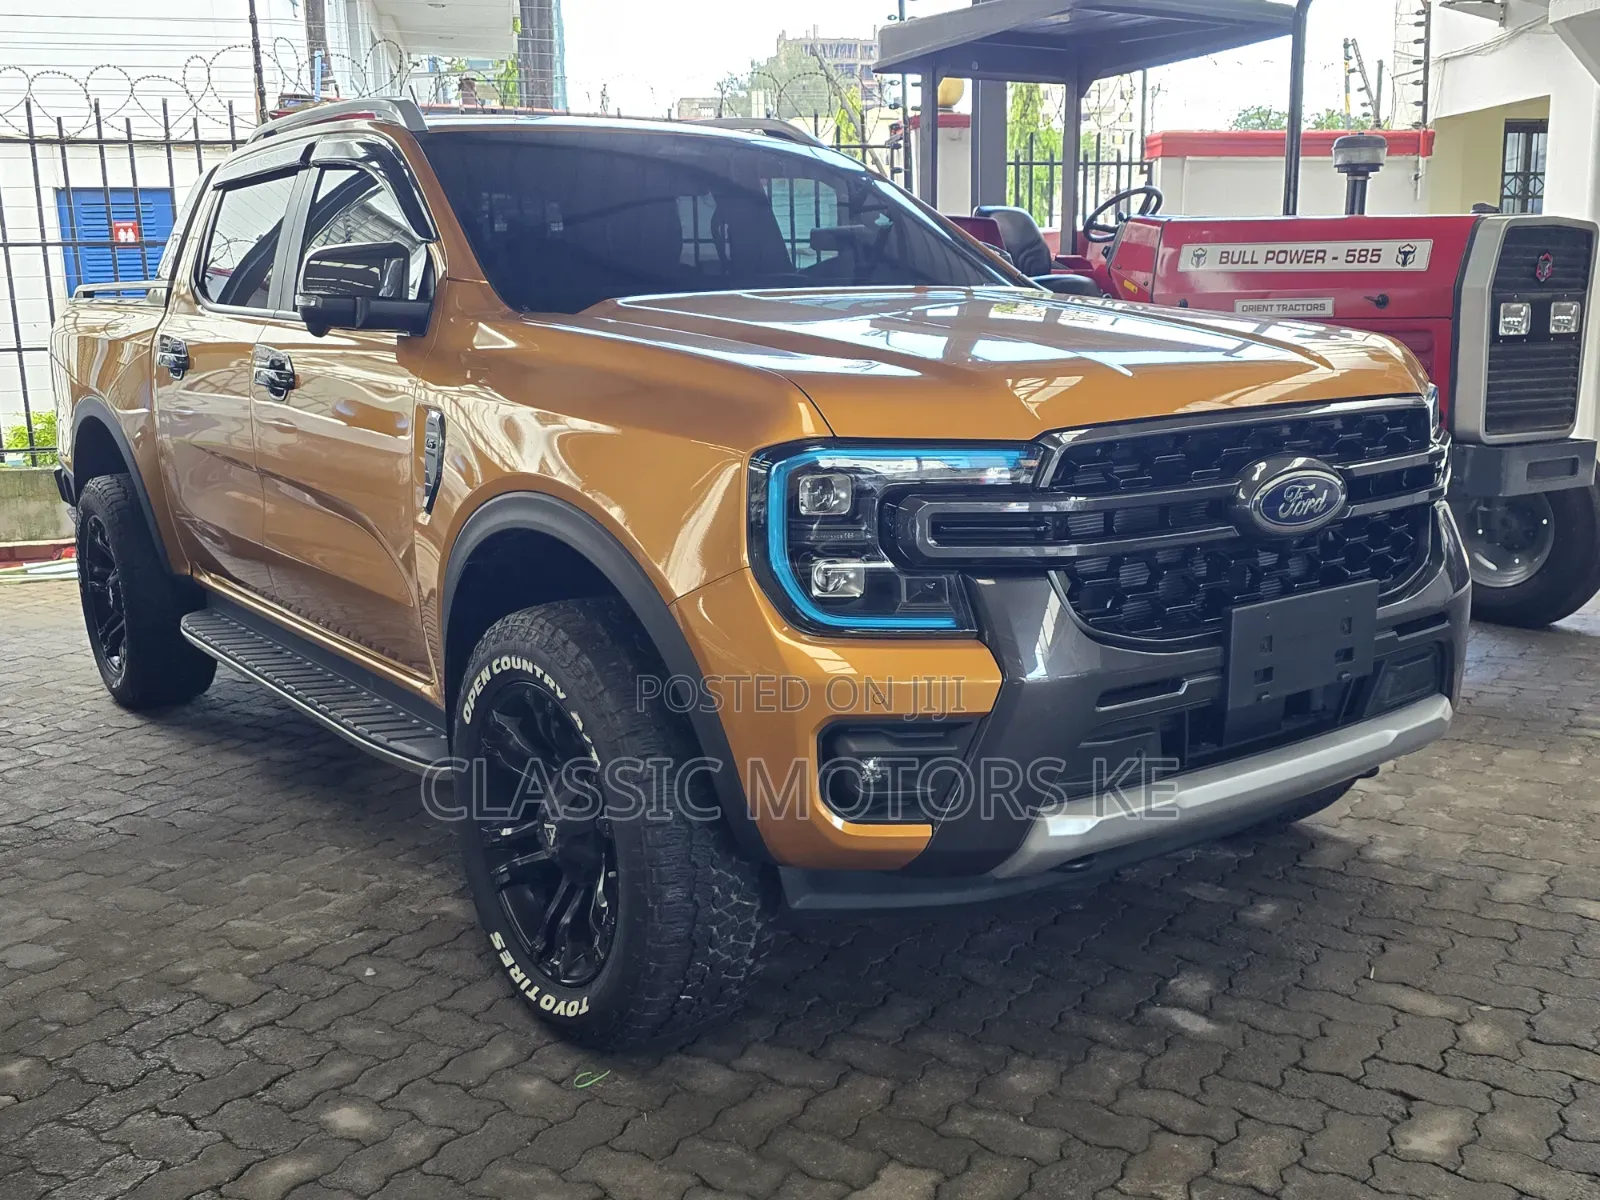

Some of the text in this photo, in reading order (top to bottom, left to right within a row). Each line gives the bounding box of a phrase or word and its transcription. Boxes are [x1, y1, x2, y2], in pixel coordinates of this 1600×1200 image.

[1218, 249, 1259, 265] BULL
[1264, 249, 1327, 264] POWER
[1344, 248, 1382, 264] 585
[1241, 302, 1326, 313] ORIENT TRACTORS
[1279, 484, 1328, 518] Ford
[463, 665, 492, 725] OPEN
[492, 655, 567, 700] COUNTRY
[489, 931, 589, 1017] TOYO TIRES
